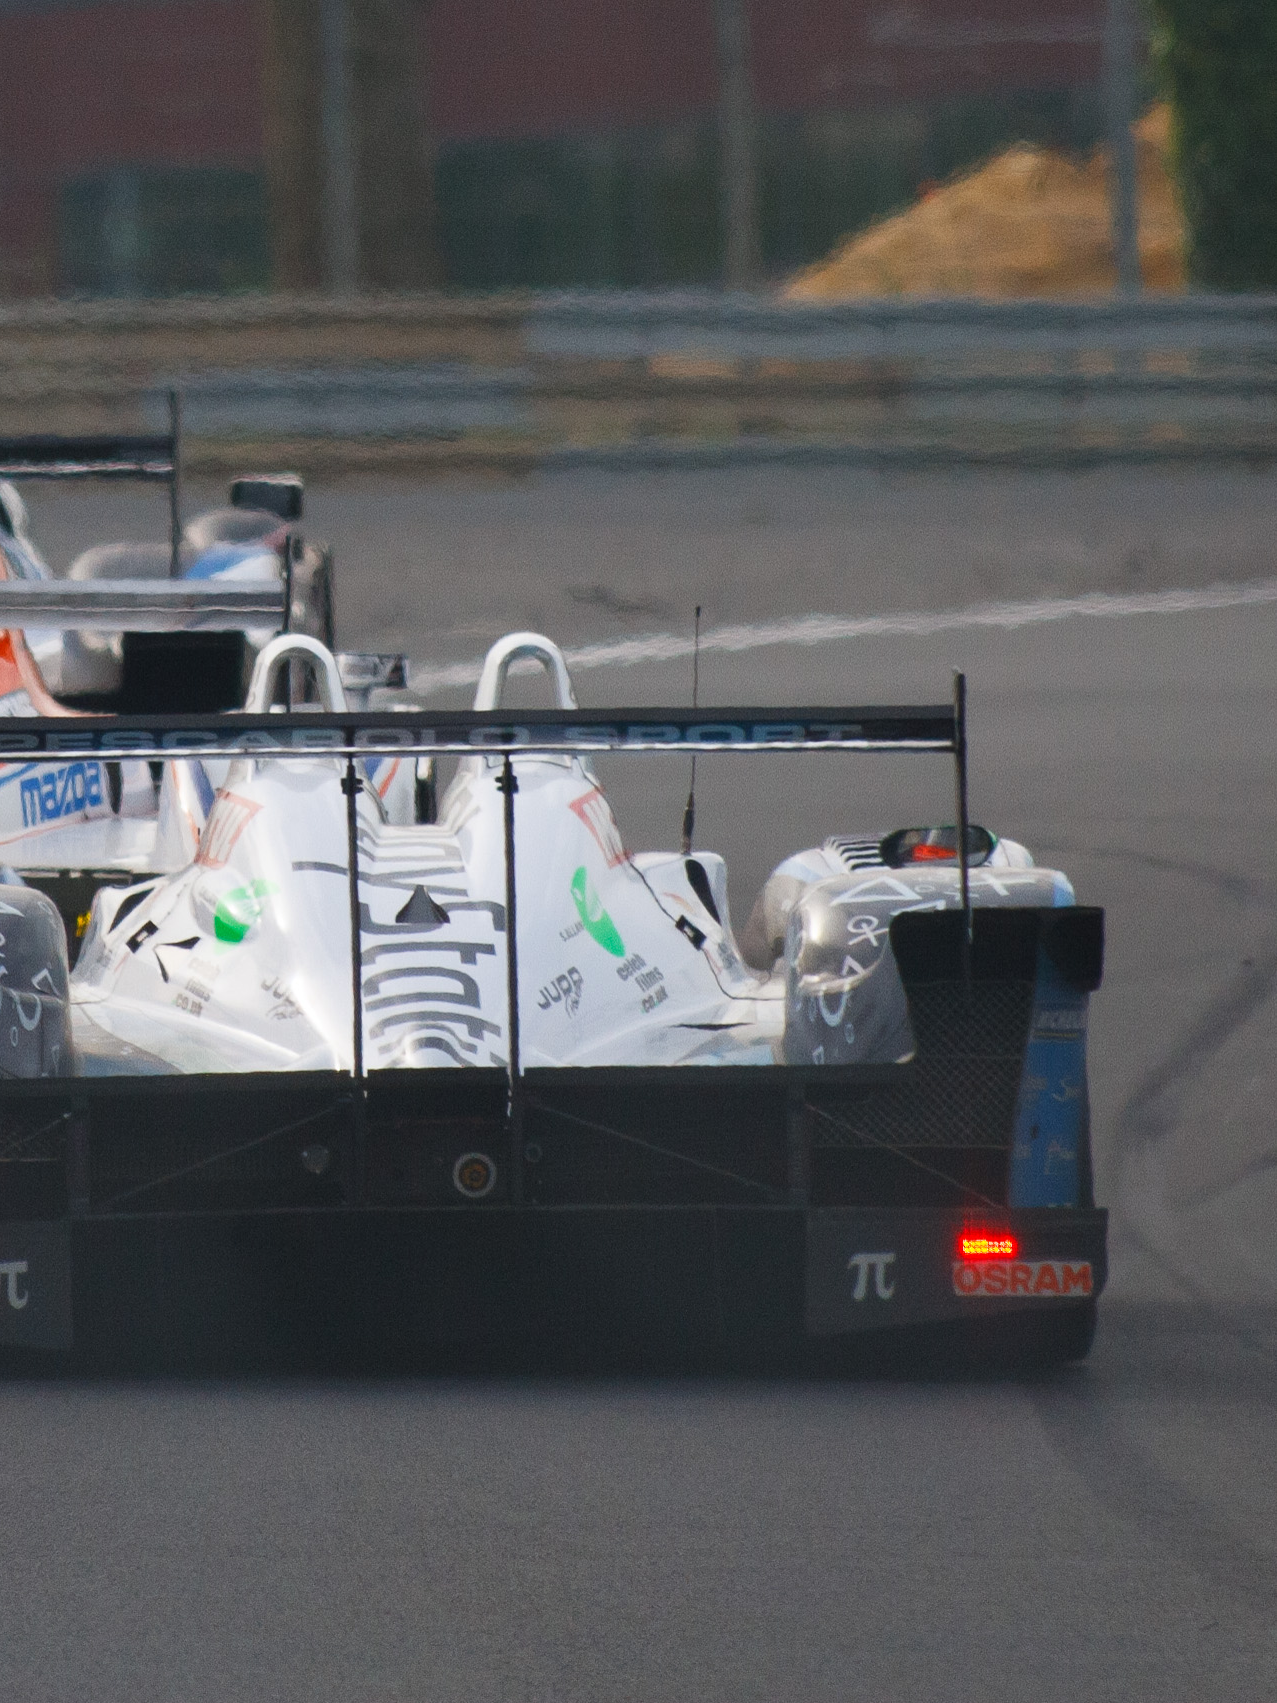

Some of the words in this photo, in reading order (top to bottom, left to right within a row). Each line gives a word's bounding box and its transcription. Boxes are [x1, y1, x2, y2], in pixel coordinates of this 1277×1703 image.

[565, 723, 863, 744] SPORT
[20, 761, 103, 828] mazda
[953, 1263, 1093, 1295] OSRAM
